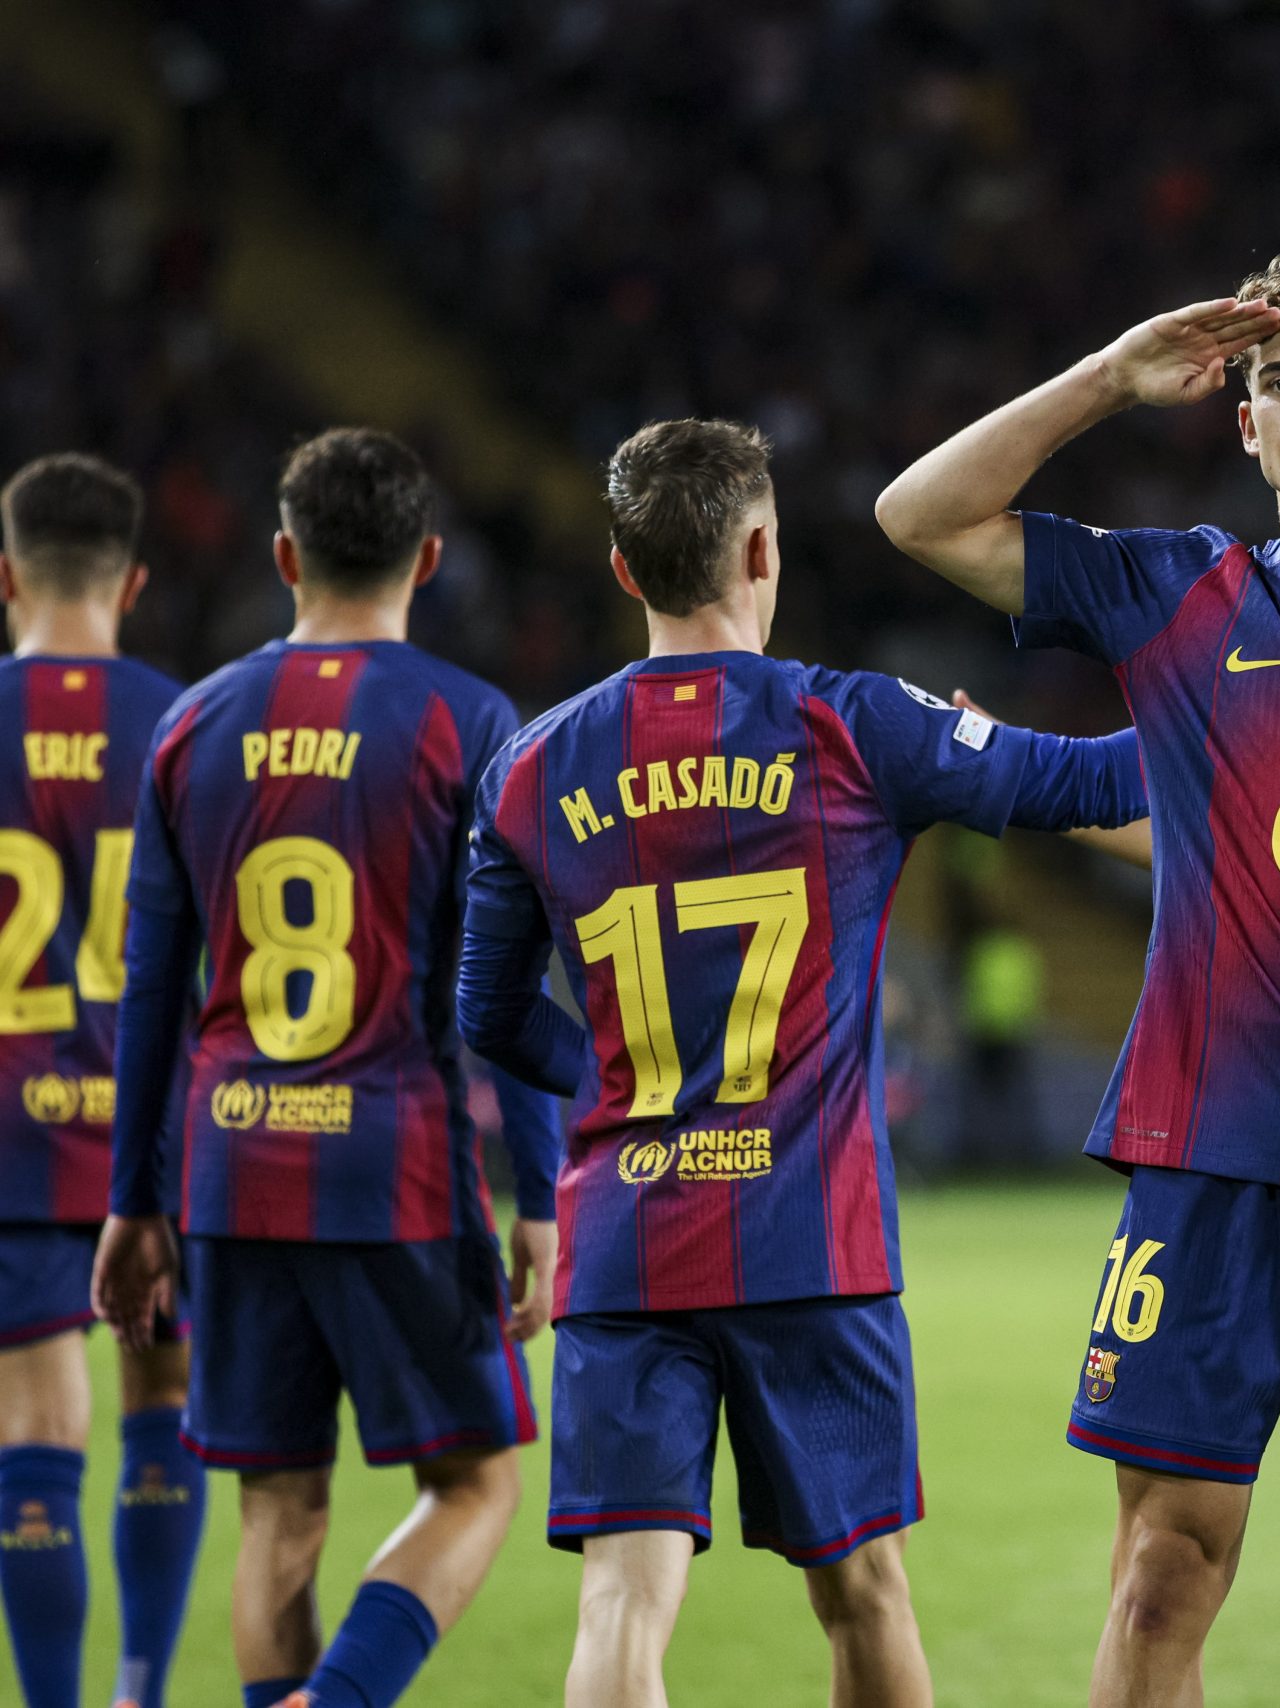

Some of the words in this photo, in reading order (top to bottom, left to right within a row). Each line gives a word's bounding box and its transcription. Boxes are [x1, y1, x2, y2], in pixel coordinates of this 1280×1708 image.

[23, 732, 108, 782] ERIC
[242, 728, 361, 782] PEDRI
[559, 787, 615, 843] M.
[617, 752, 796, 816] CASADÓ
[235, 836, 356, 1061] 8
[574, 867, 810, 1118] 17
[676, 1150, 772, 1172] ACNUR
[679, 1128, 771, 1151] UNHCR
[677, 1172, 693, 1181] The
[694, 1172, 707, 1181] UN
[707, 1172, 741, 1182] Refugee
[742, 1168, 772, 1180] Agency
[1092, 1233, 1166, 1343] 16
